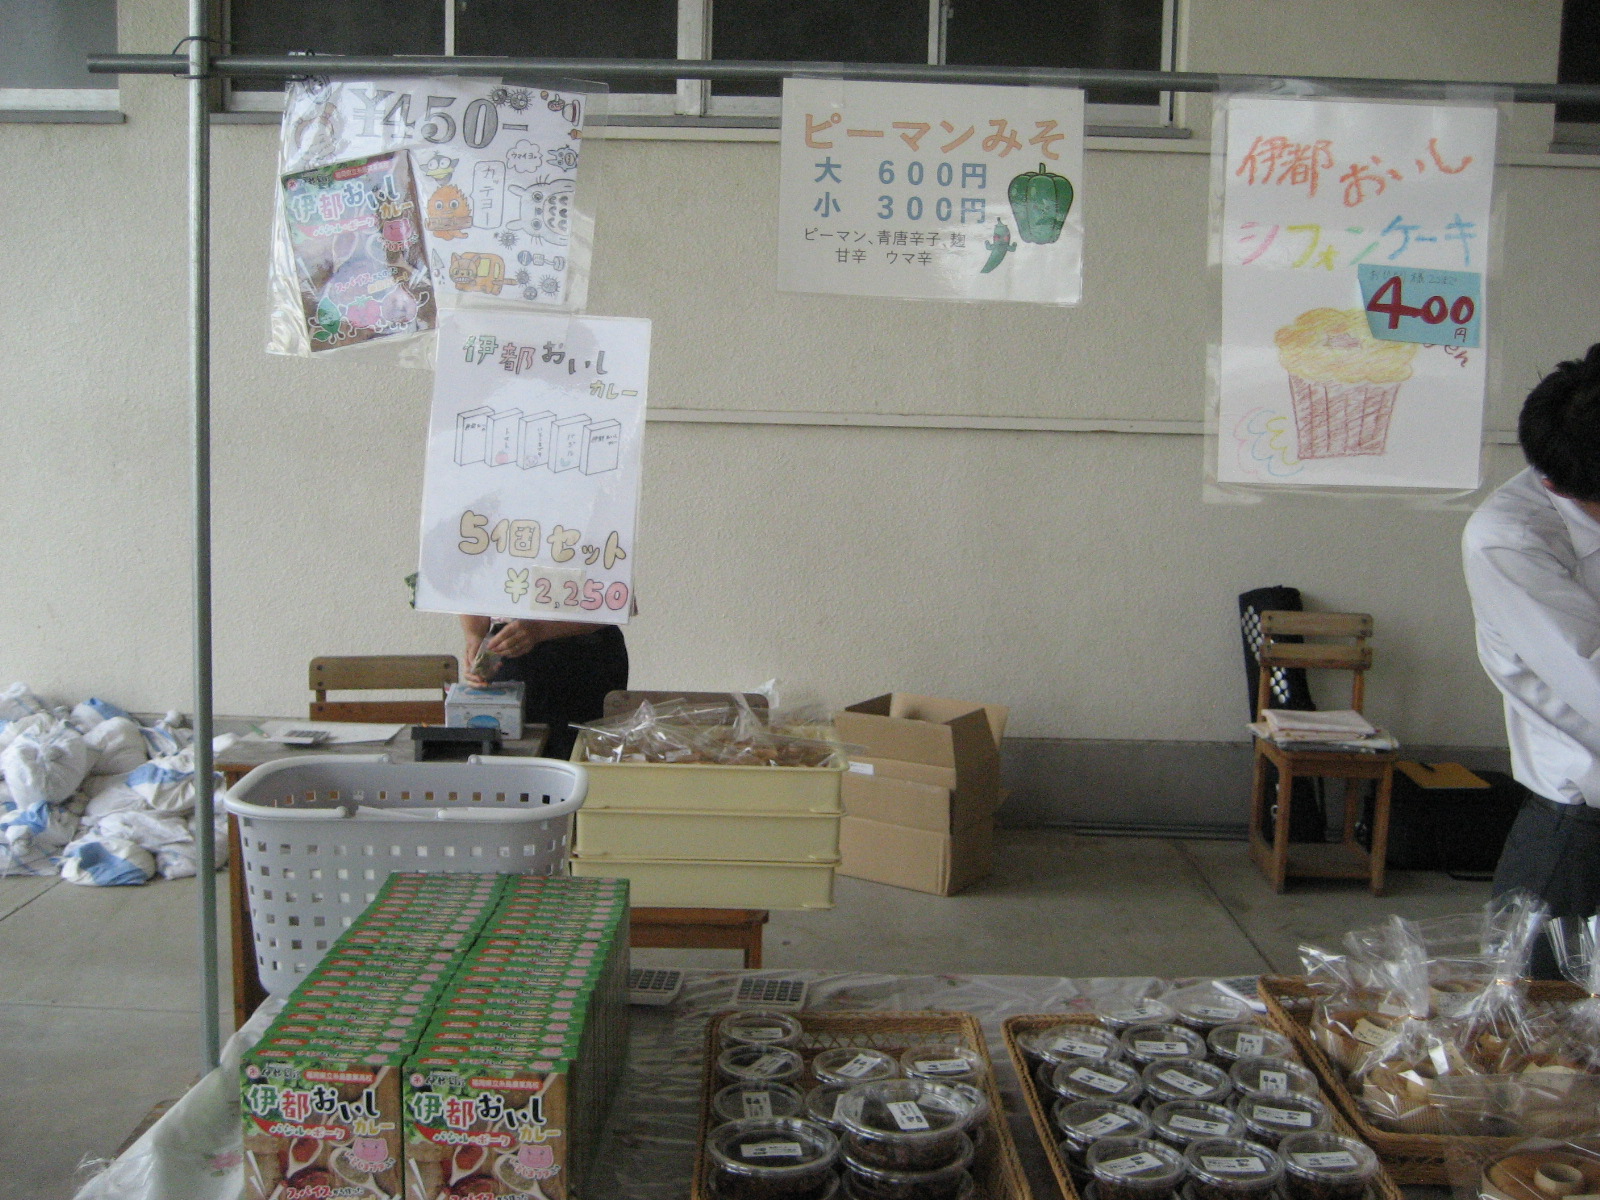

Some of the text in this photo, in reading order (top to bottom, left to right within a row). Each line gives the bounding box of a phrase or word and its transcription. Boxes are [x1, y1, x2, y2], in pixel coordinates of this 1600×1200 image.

[804, 112, 1065, 161] ピーマンみそ
[814, 157, 988, 190] 大 600円
[1236, 134, 1473, 207] 伊都おいし
[813, 191, 987, 224] 小 300円
[835, 248, 933, 267] 甘辛 ウマ辛
[1239, 213, 1478, 271] シフォンケーキ
[1367, 275, 1475, 330] 400
[1453, 327, 1468, 343] 円
[462, 335, 608, 375] 伊都おいし
[589, 379, 639, 399] カレー
[504, 567, 629, 611] ¥2,250
[248, 1085, 381, 1123] 伊都おいし
[412, 1092, 547, 1131] 伊都おいし
[353, 1119, 395, 1136] カレー
[518, 1126, 561, 1143] カレー
